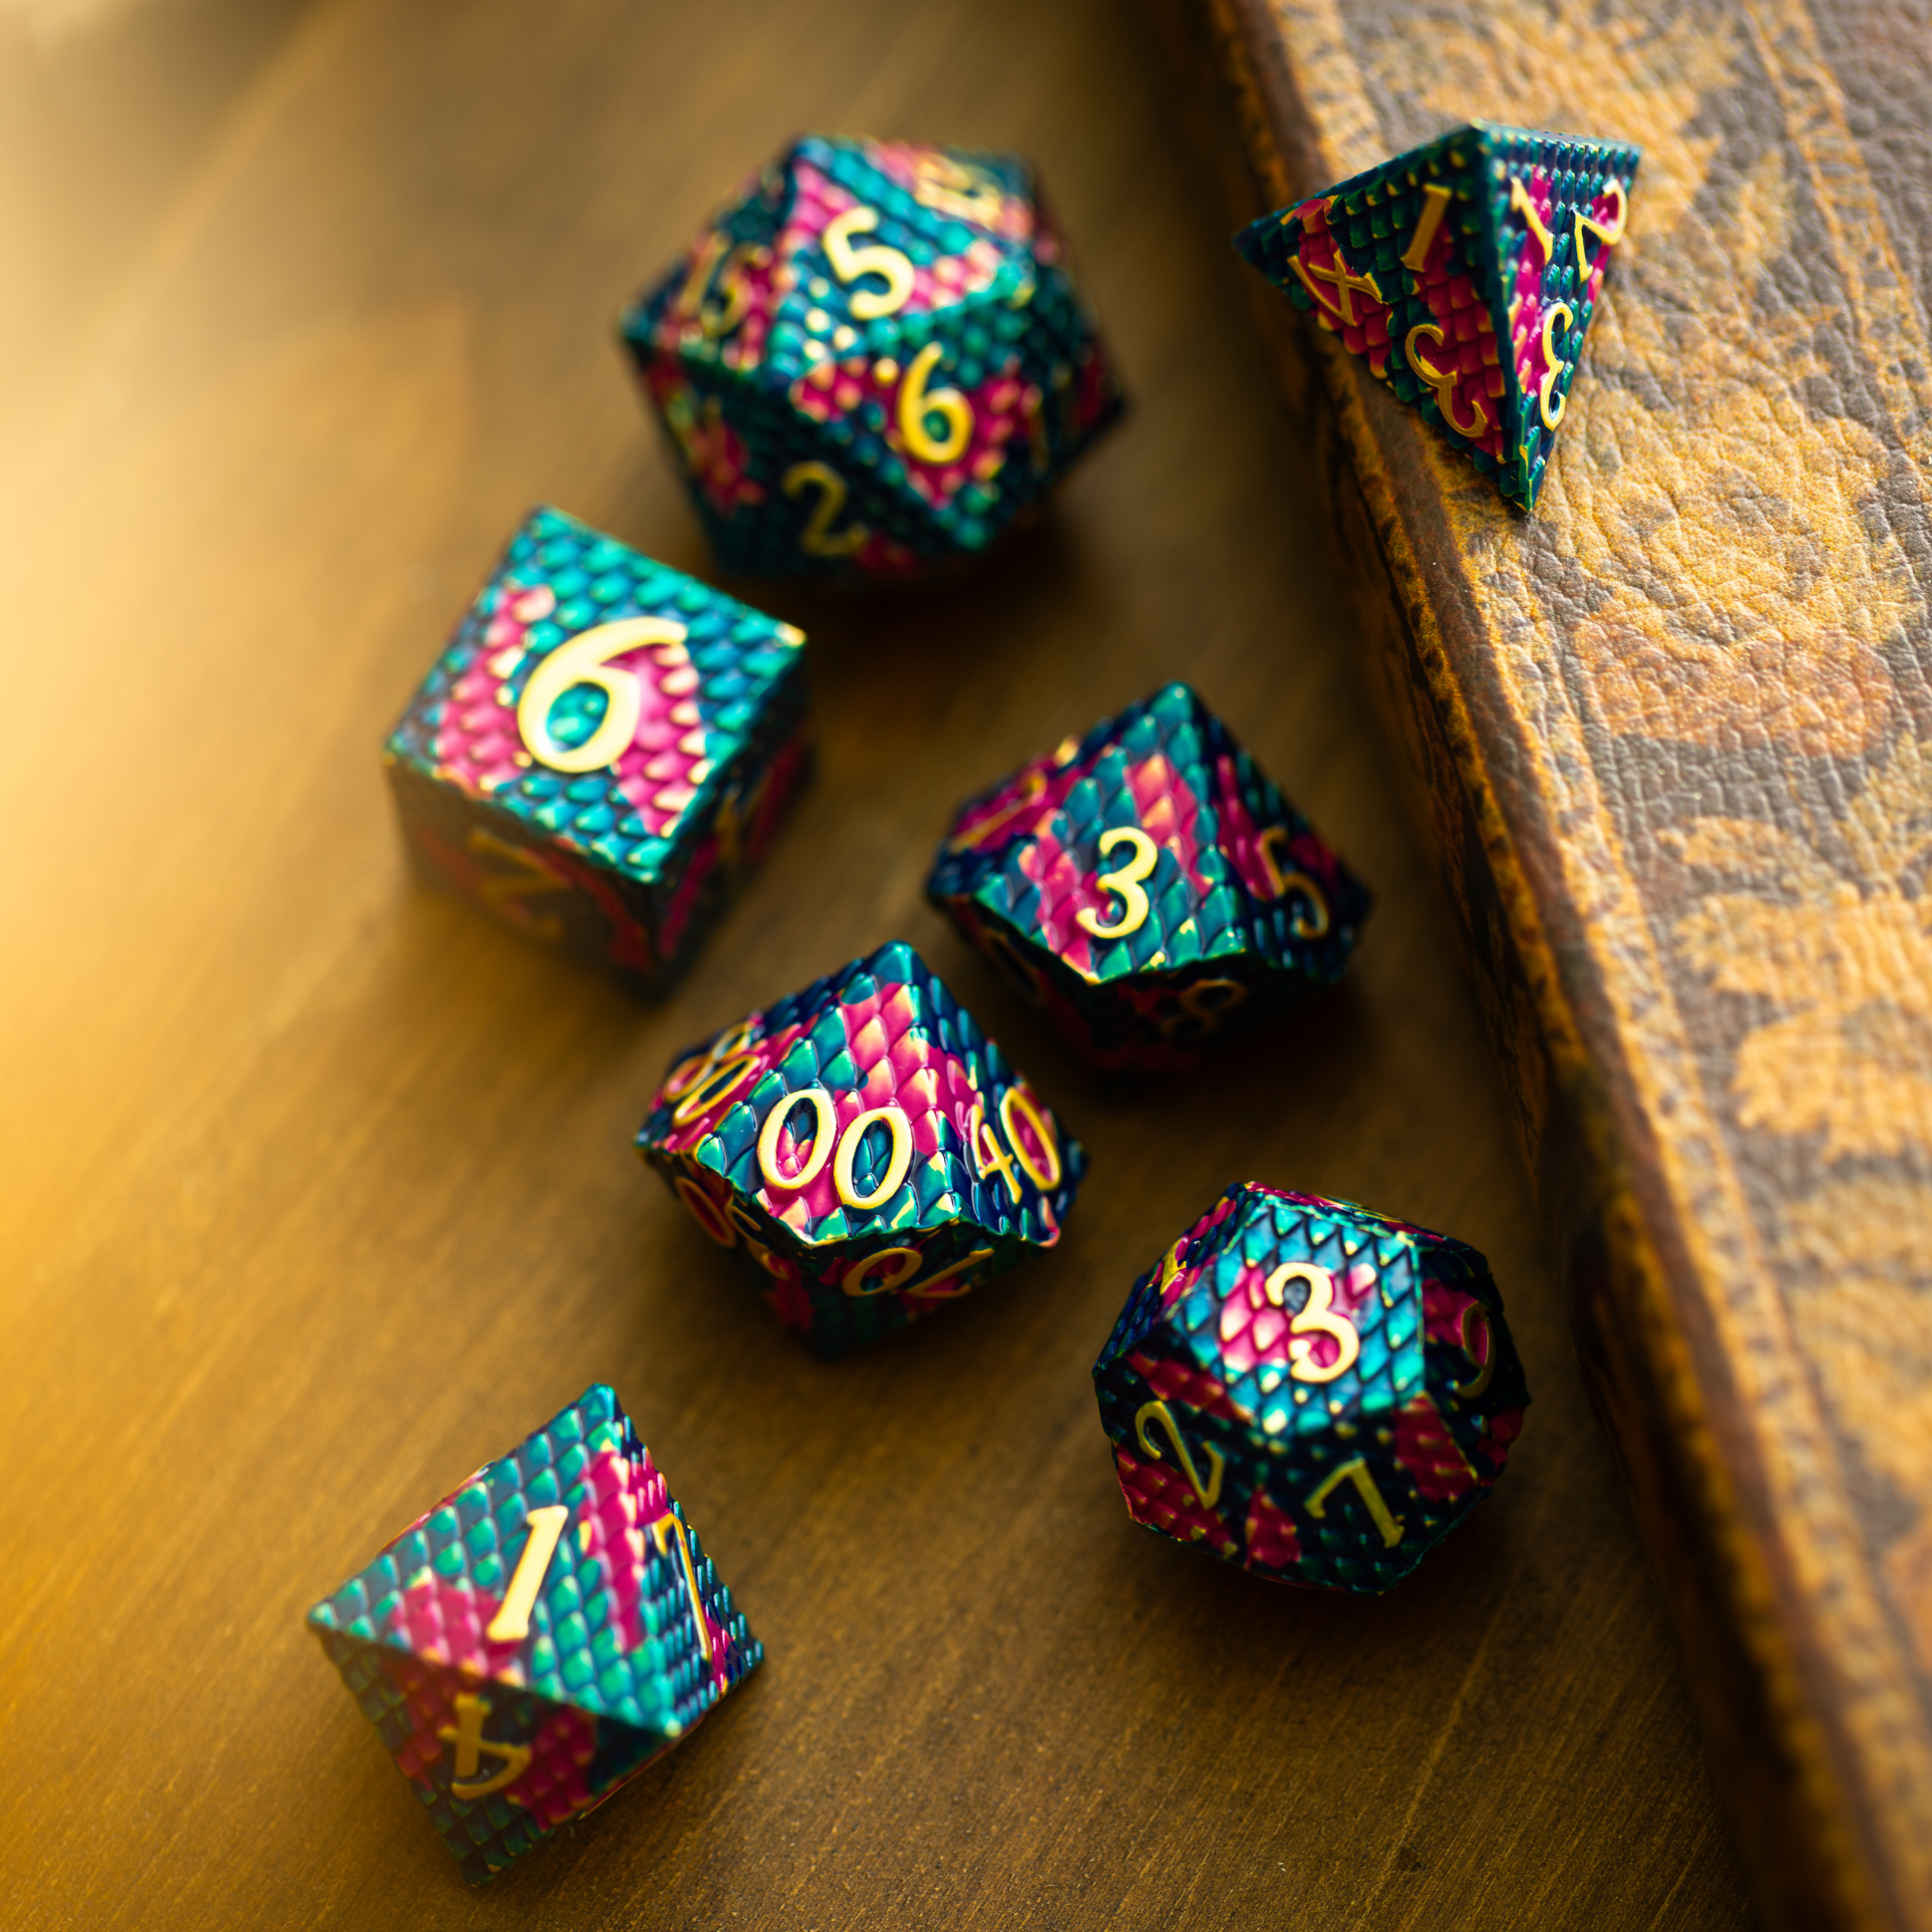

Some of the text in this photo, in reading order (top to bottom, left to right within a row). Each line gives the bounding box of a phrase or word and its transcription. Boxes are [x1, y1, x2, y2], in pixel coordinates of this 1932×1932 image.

[821, 205, 915, 321] 5
[1400, 183, 1452, 273] 1
[898, 341, 976, 464] 6
[1406, 324, 1487, 439] 3
[1540, 302, 1573, 432] 3
[783, 462, 869, 557] 2
[516, 615, 689, 774] 6
[1076, 826, 1157, 939] 3
[1258, 826, 1329, 940] 5
[663, 1022, 762, 1127] 80
[758, 1088, 912, 1209] 00
[969, 1086, 1063, 1203] 40
[1264, 1261, 1359, 1384] 3
[1134, 1400, 1225, 1511] 2
[1304, 1456, 1405, 1549] 7
[486, 1505, 569, 1642] 1
[652, 1508, 713, 1661] 7
